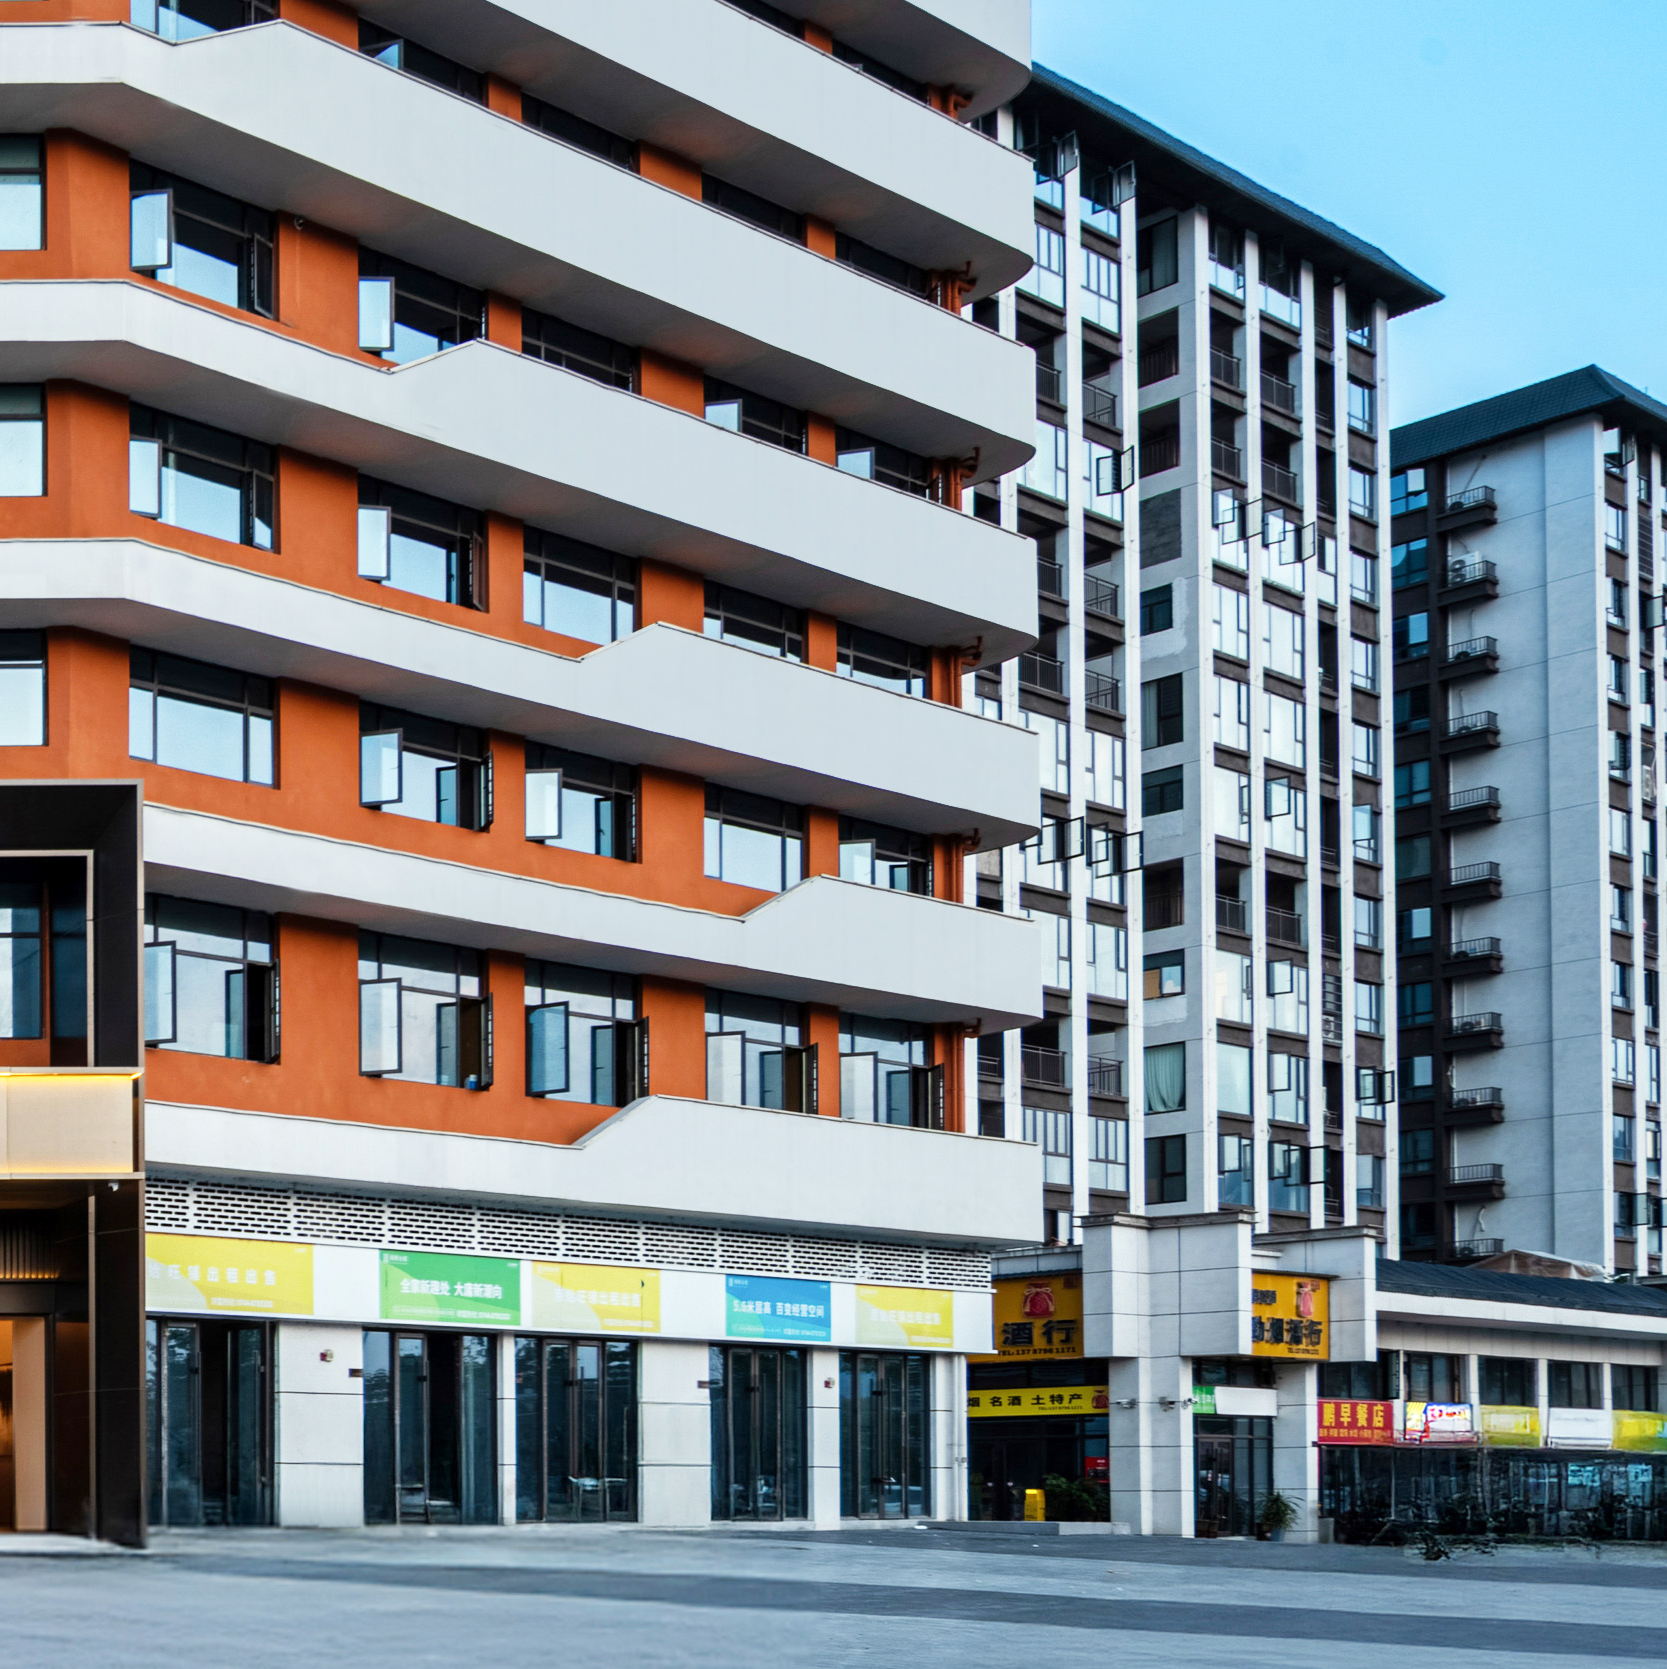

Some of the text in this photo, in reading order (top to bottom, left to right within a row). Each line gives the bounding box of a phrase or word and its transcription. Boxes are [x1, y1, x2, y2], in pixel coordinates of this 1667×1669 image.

[1001, 1319, 1078, 1347] 酒行
[989, 1395, 1023, 1408] 名酒
[1030, 1393, 1084, 1406] 土特产
